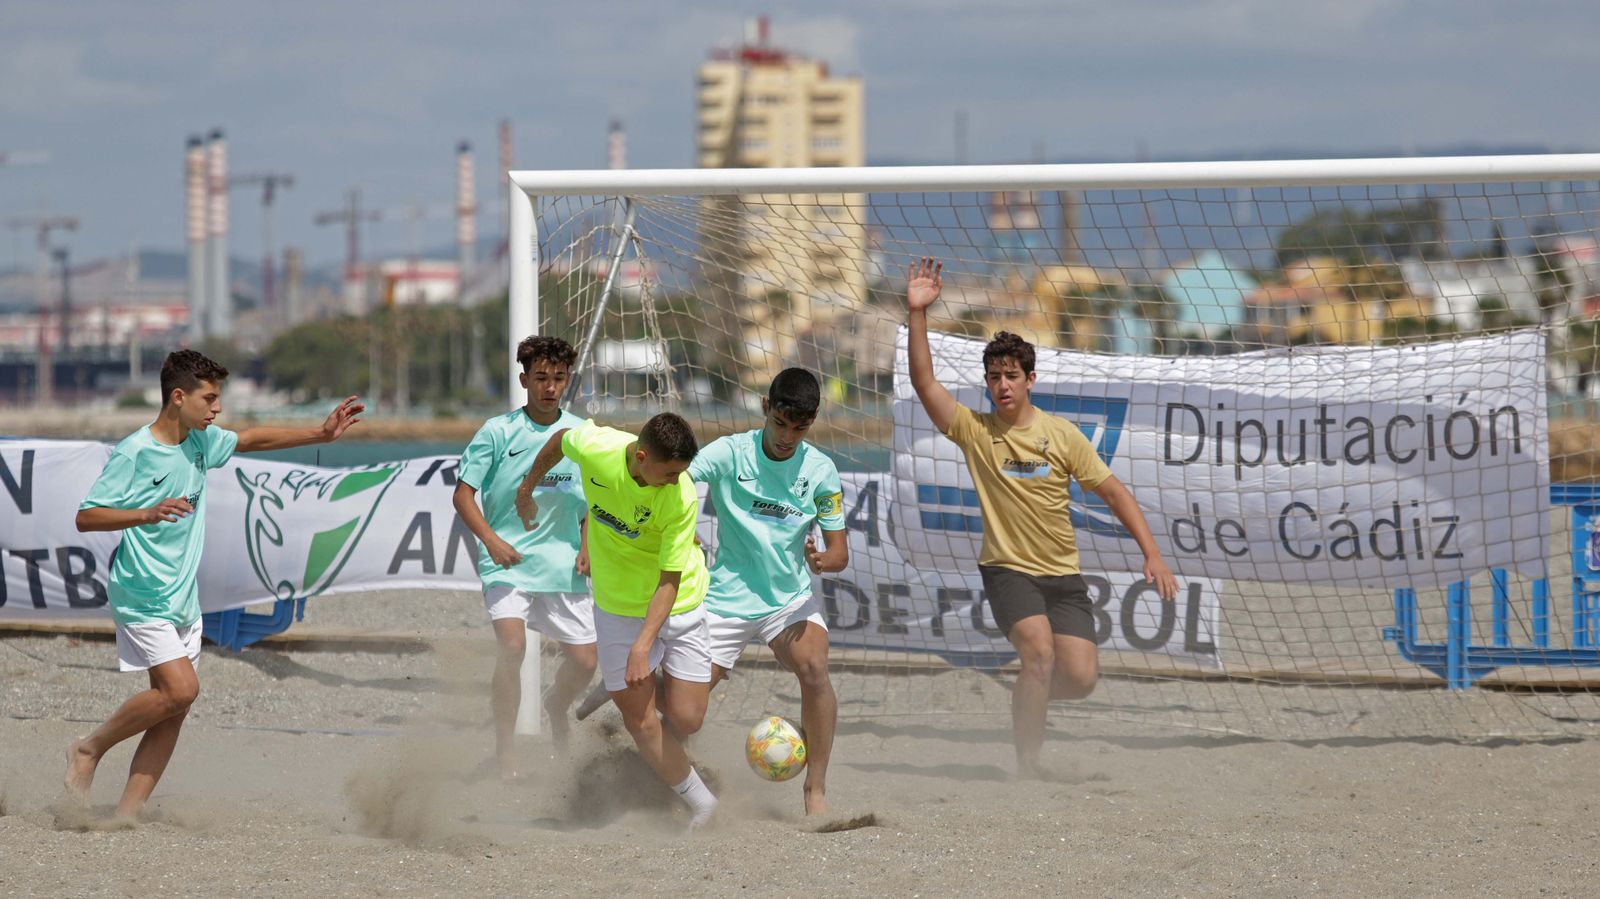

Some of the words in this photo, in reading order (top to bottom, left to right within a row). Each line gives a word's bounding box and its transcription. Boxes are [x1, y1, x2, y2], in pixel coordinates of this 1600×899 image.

[1164, 392, 1521, 480] Diputación
[752, 500, 803, 517] Torralva
[1172, 503, 1249, 558] de
[1278, 501, 1464, 562] Cádiz
[822, 577, 910, 635] DE
